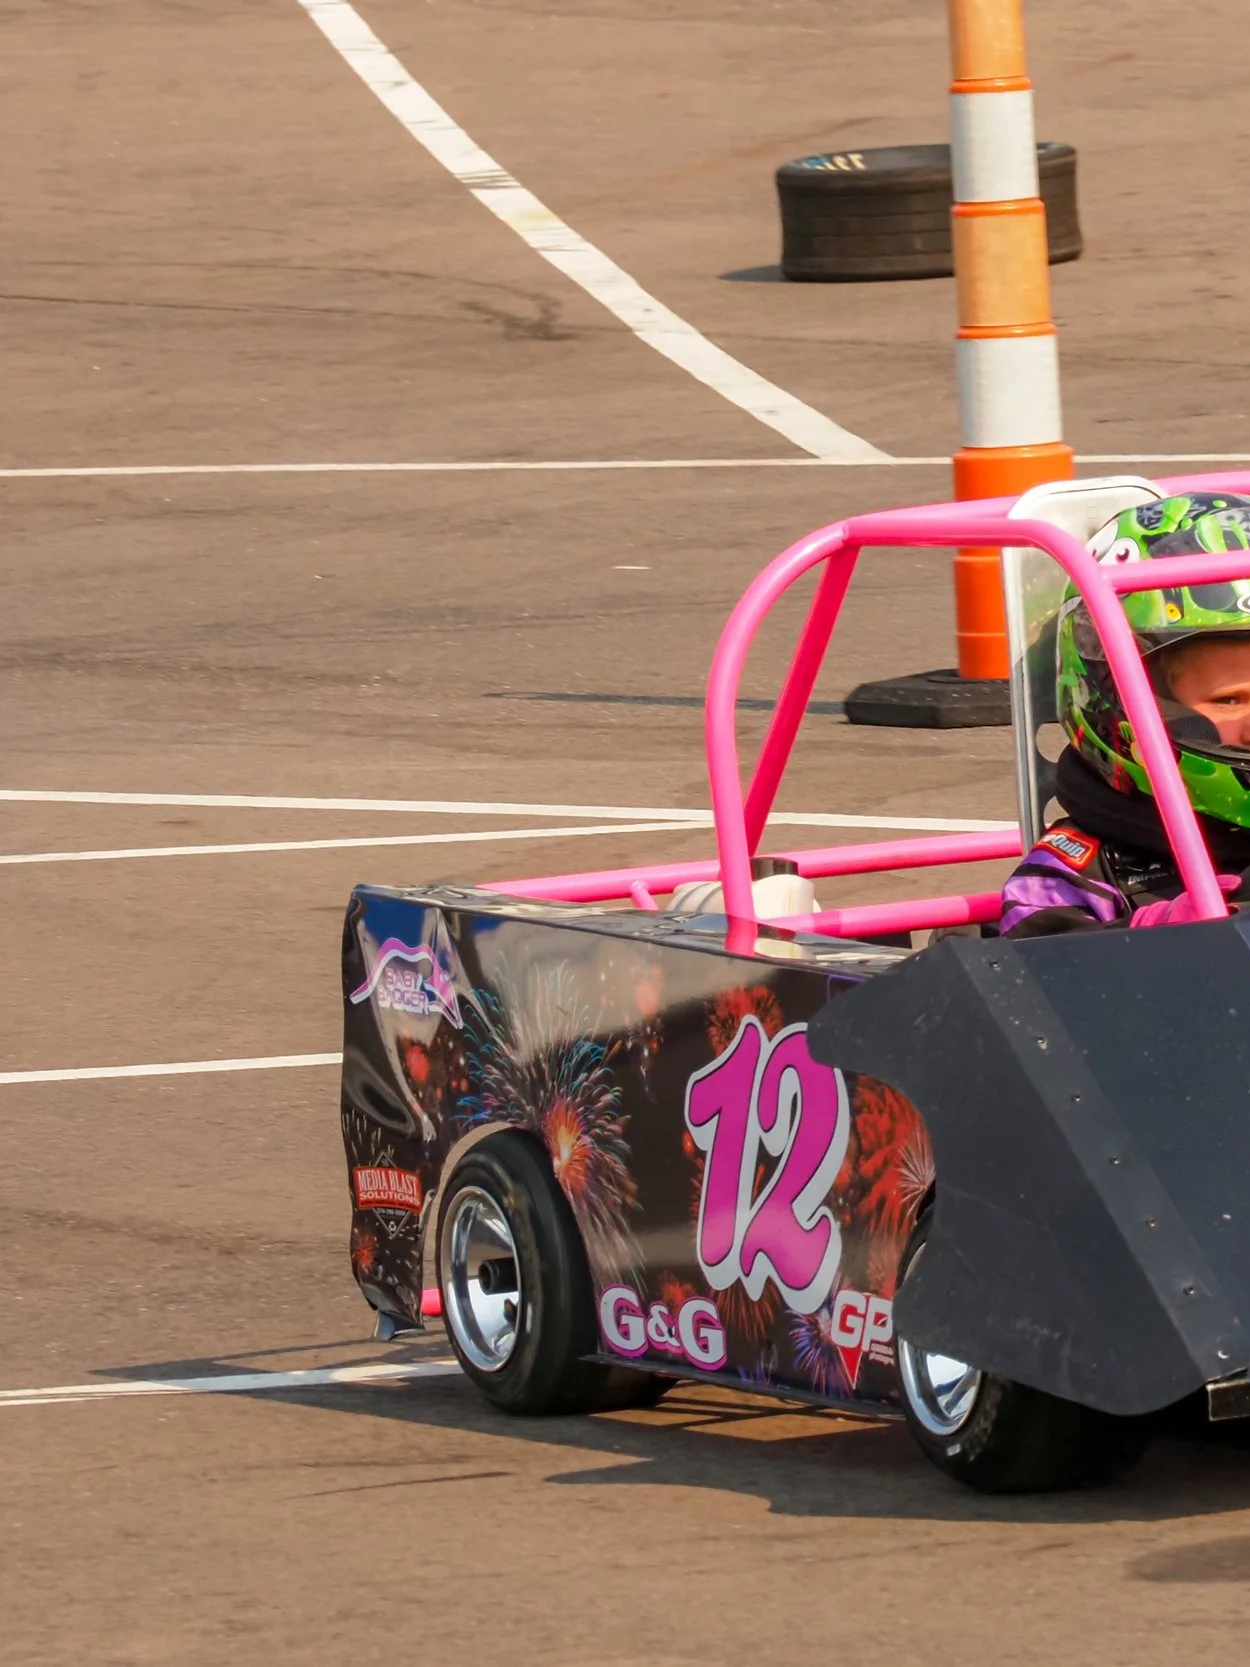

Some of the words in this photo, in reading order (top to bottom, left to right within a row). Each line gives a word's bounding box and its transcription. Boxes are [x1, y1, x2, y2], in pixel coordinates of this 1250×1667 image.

[384, 967, 423, 991] BABY
[357, 1169, 388, 1191] MEDIA
[388, 1170, 418, 1197] BLAST
[684, 1014, 850, 1315] 12
[359, 1190, 420, 1206] SOLUTIONS
[600, 1284, 727, 1371] G&G
[831, 1289, 894, 1352] GP
